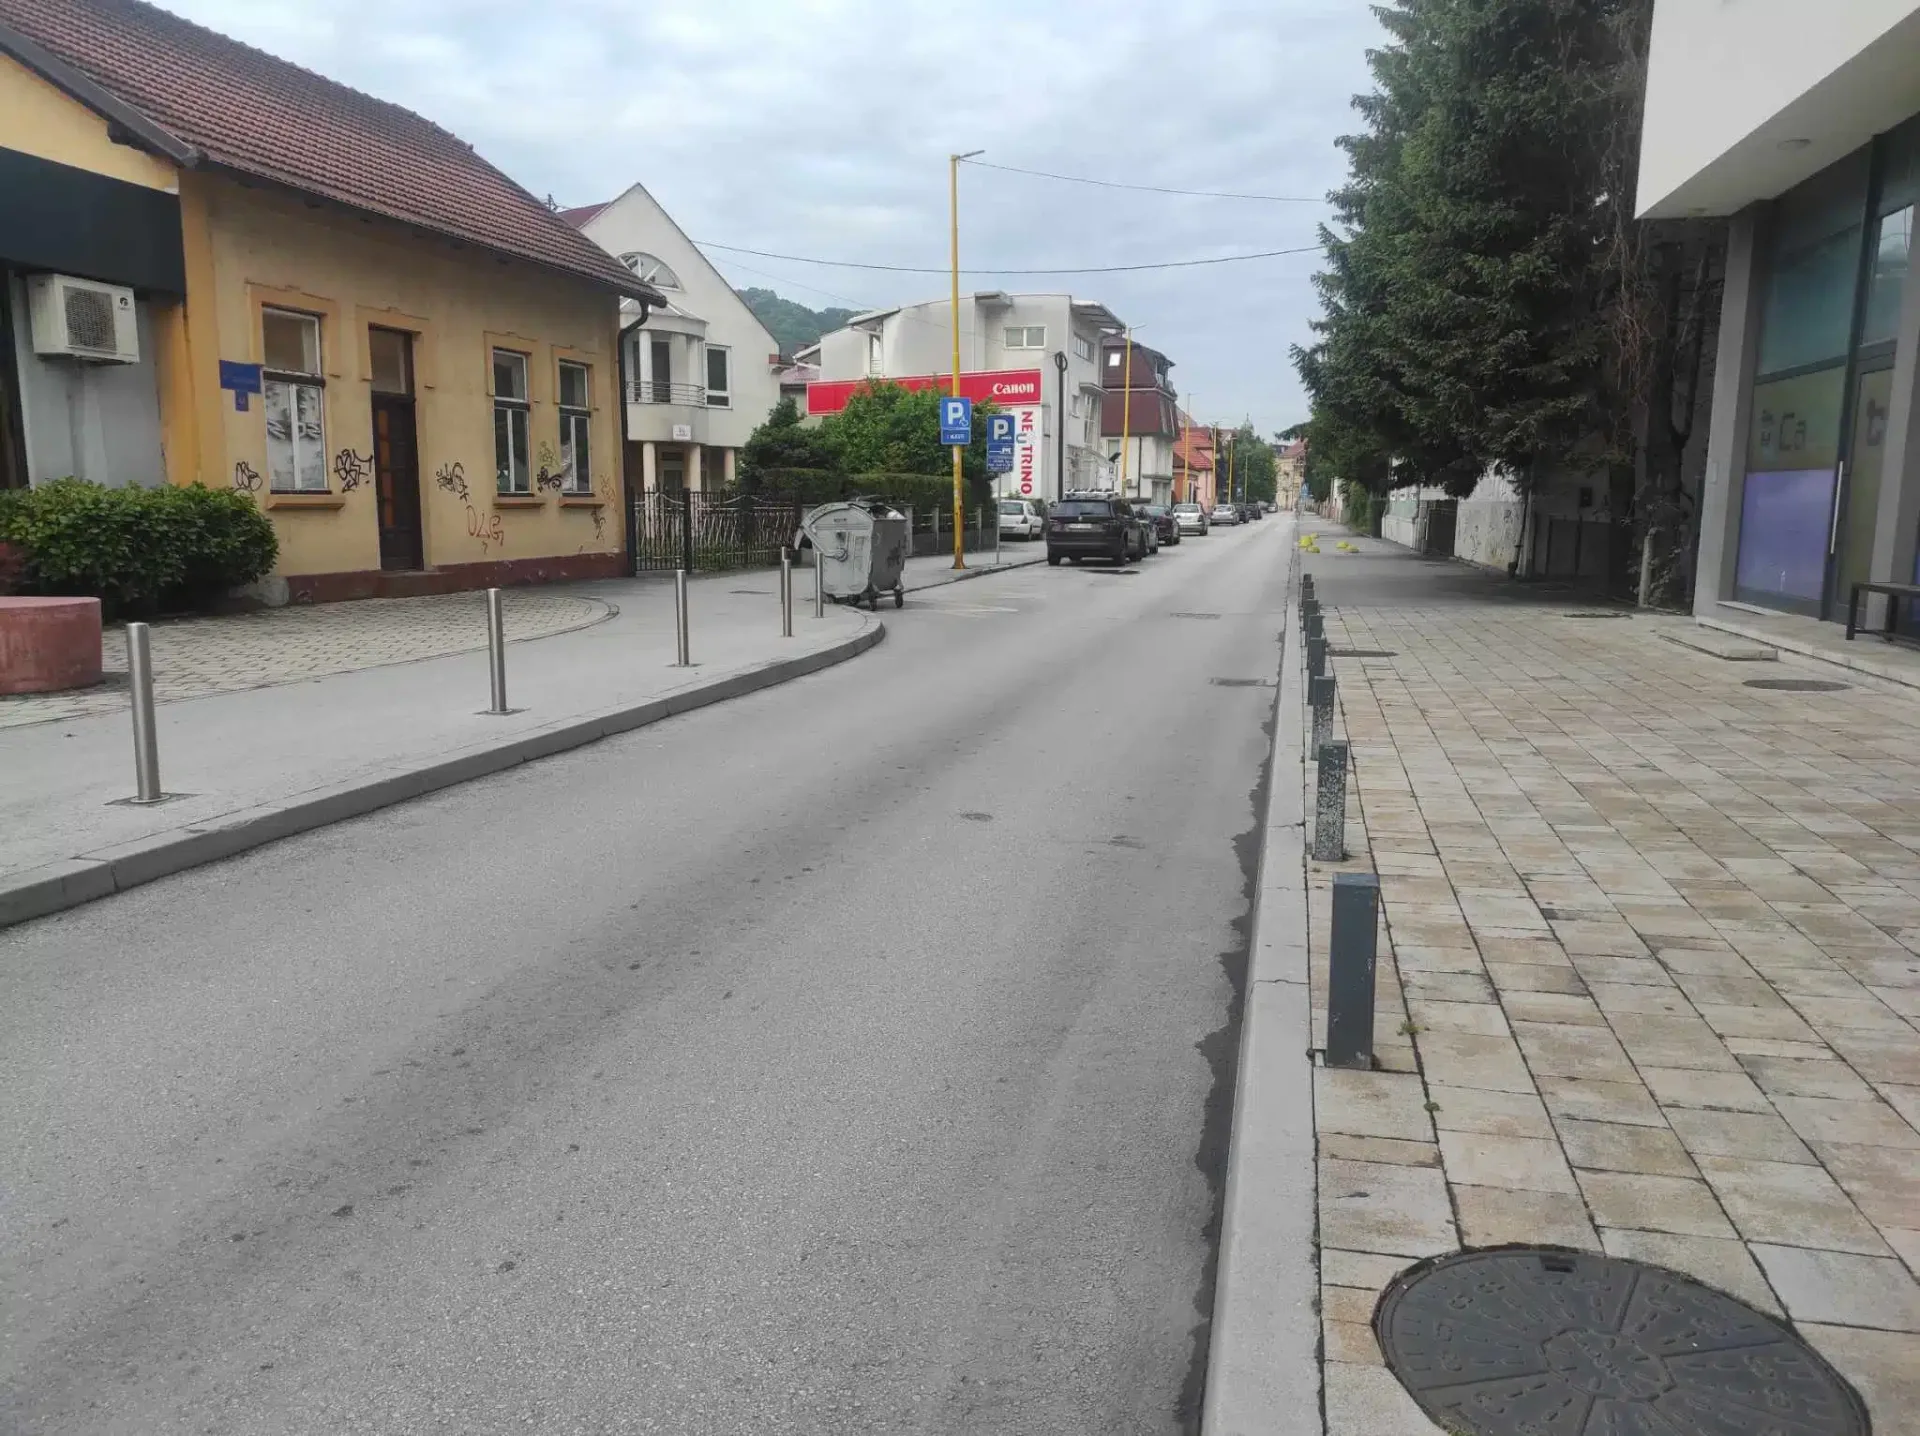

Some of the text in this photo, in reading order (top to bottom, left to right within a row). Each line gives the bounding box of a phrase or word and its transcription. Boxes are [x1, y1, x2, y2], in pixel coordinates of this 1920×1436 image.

[992, 383, 1035, 395] Canon
[948, 402, 964, 425] P
[994, 419, 1009, 440] P
[1016, 411, 1033, 494] NEUTRINO
